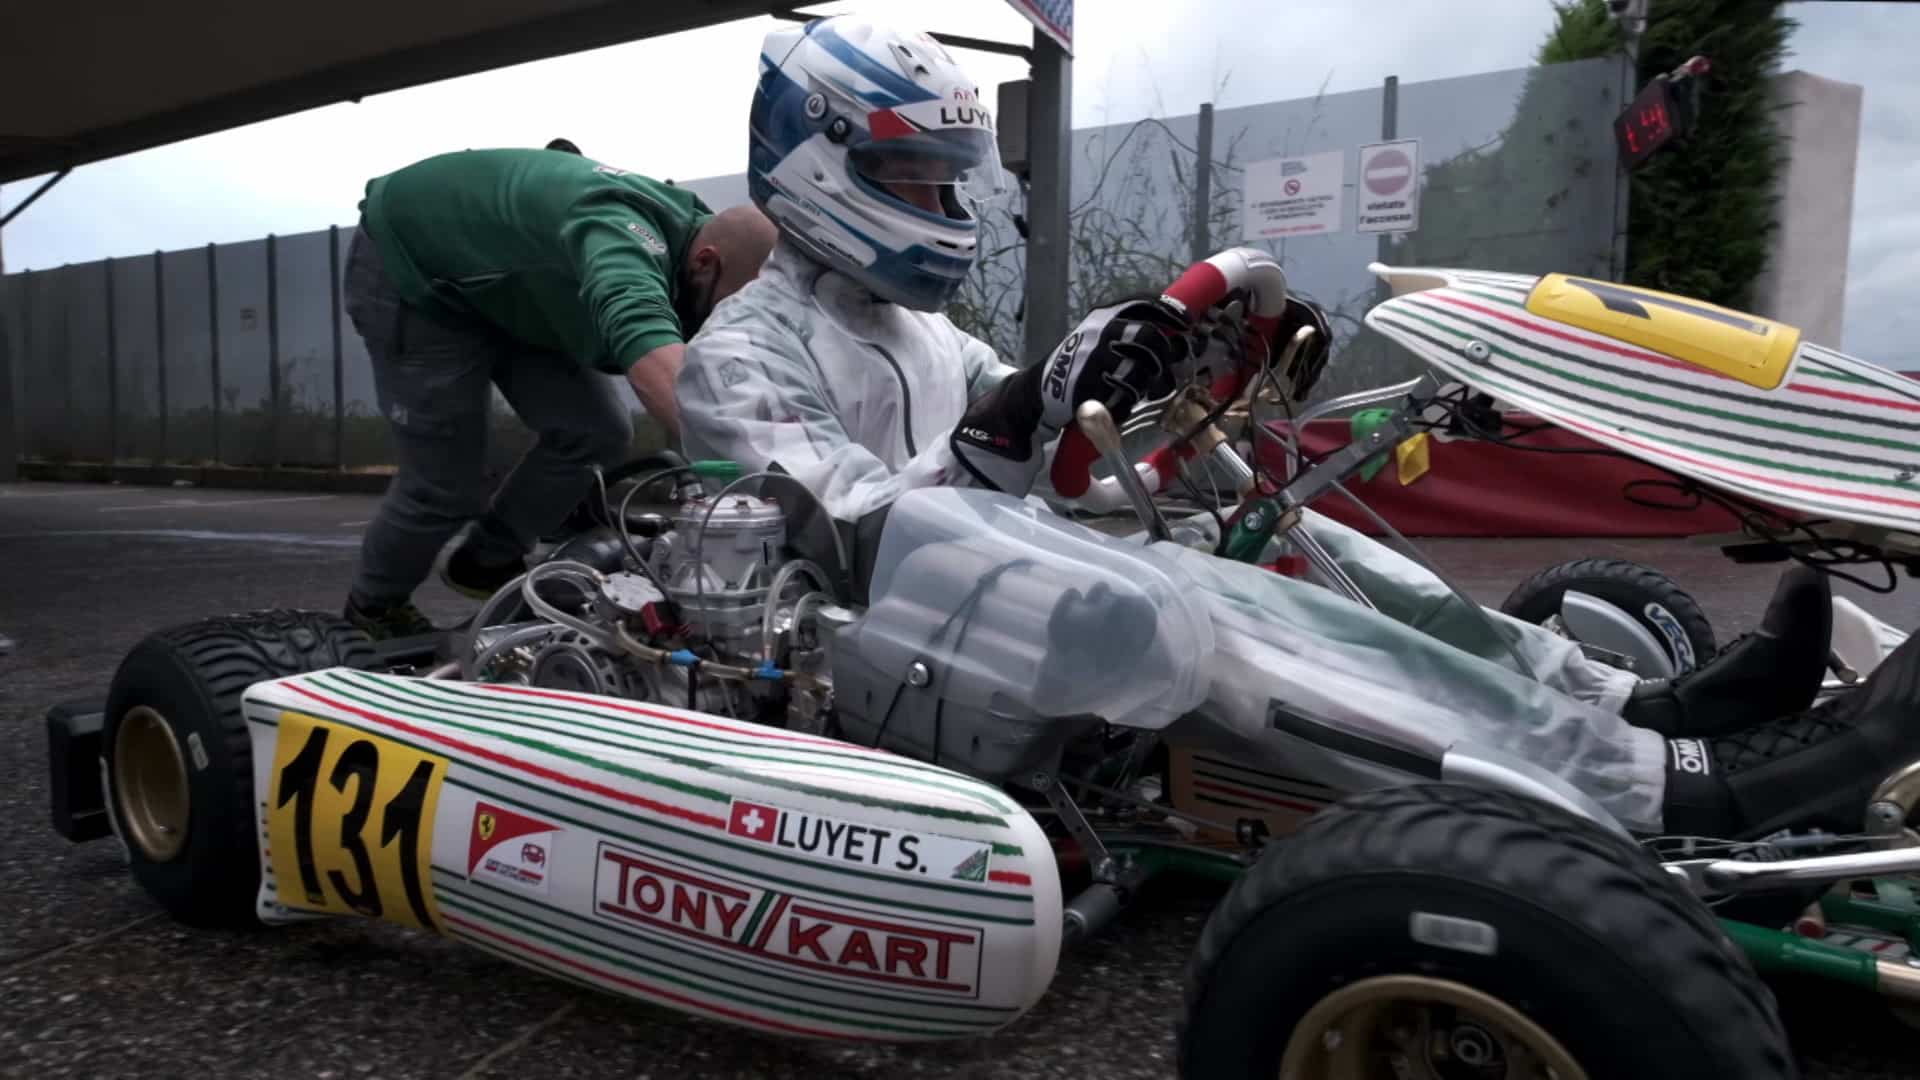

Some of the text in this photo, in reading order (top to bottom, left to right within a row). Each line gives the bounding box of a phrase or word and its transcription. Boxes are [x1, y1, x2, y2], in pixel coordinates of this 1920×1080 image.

[1049, 332, 1079, 400] OMP
[277, 726, 443, 934] 131
[776, 811, 892, 865] LUYET
[895, 834, 928, 874] S.
[603, 849, 976, 980] TONY KART
